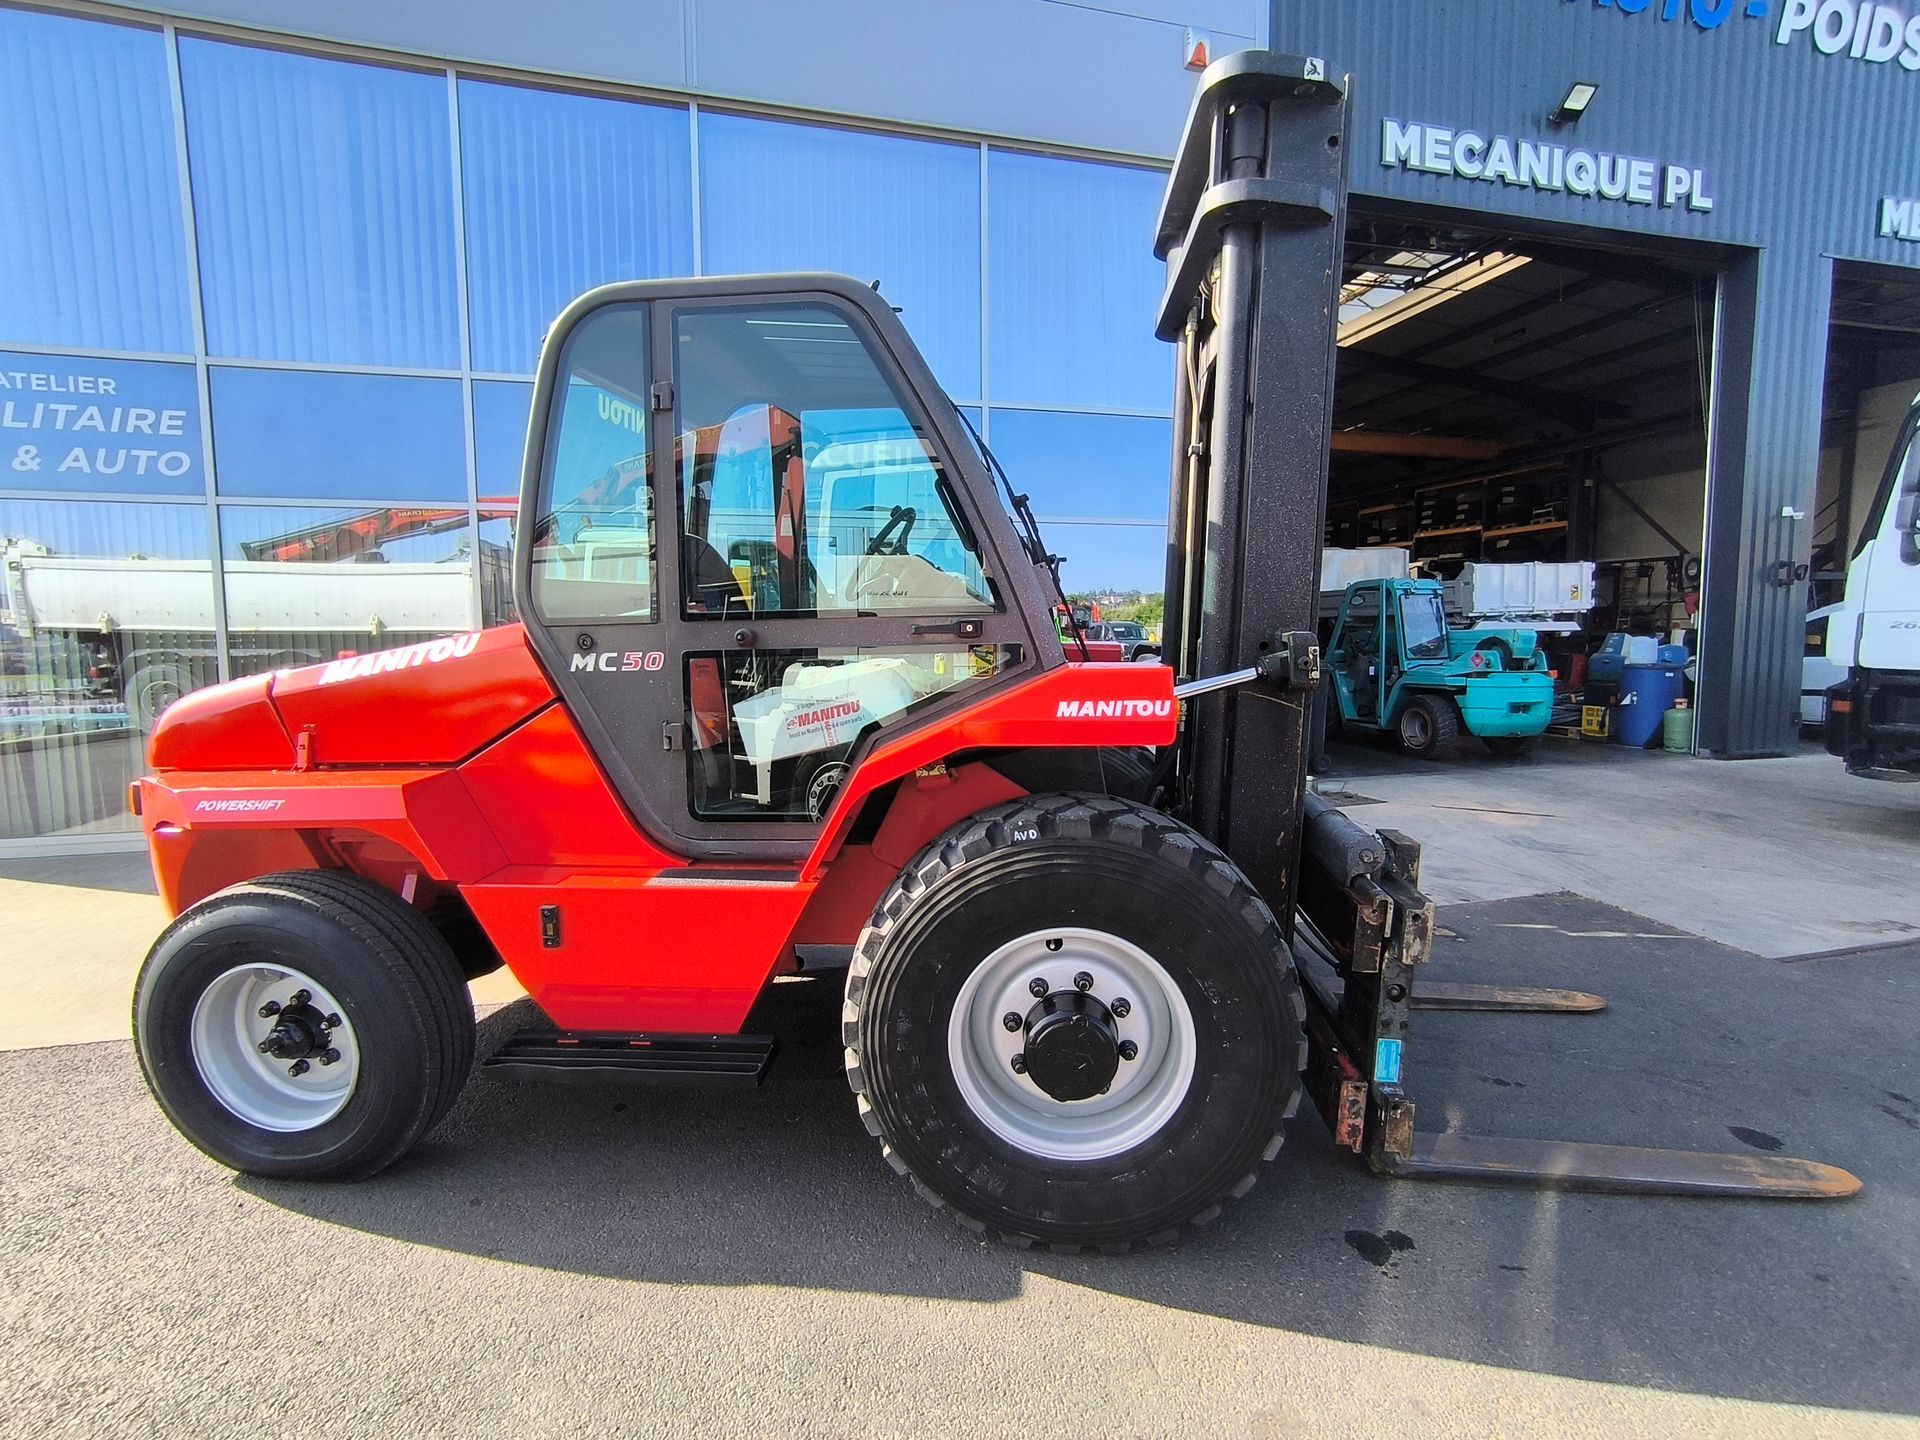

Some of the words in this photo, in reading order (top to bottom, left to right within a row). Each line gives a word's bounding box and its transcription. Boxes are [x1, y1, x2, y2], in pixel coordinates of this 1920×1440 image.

[1382, 118, 1655, 203] MECANIQUE
[1665, 164, 1714, 212] PL
[2, 400, 187, 436] LITAIRE
[11, 444, 42, 472] &
[56, 446, 191, 477] AUTO
[1889, 620, 1920, 630] 26
[317, 631, 482, 687] MANITOU
[797, 699, 861, 727] MANITOU
[1056, 699, 1171, 718] MANITOU
[195, 799, 286, 812] POWERSHIFT
[1013, 829, 1038, 842] AVD
